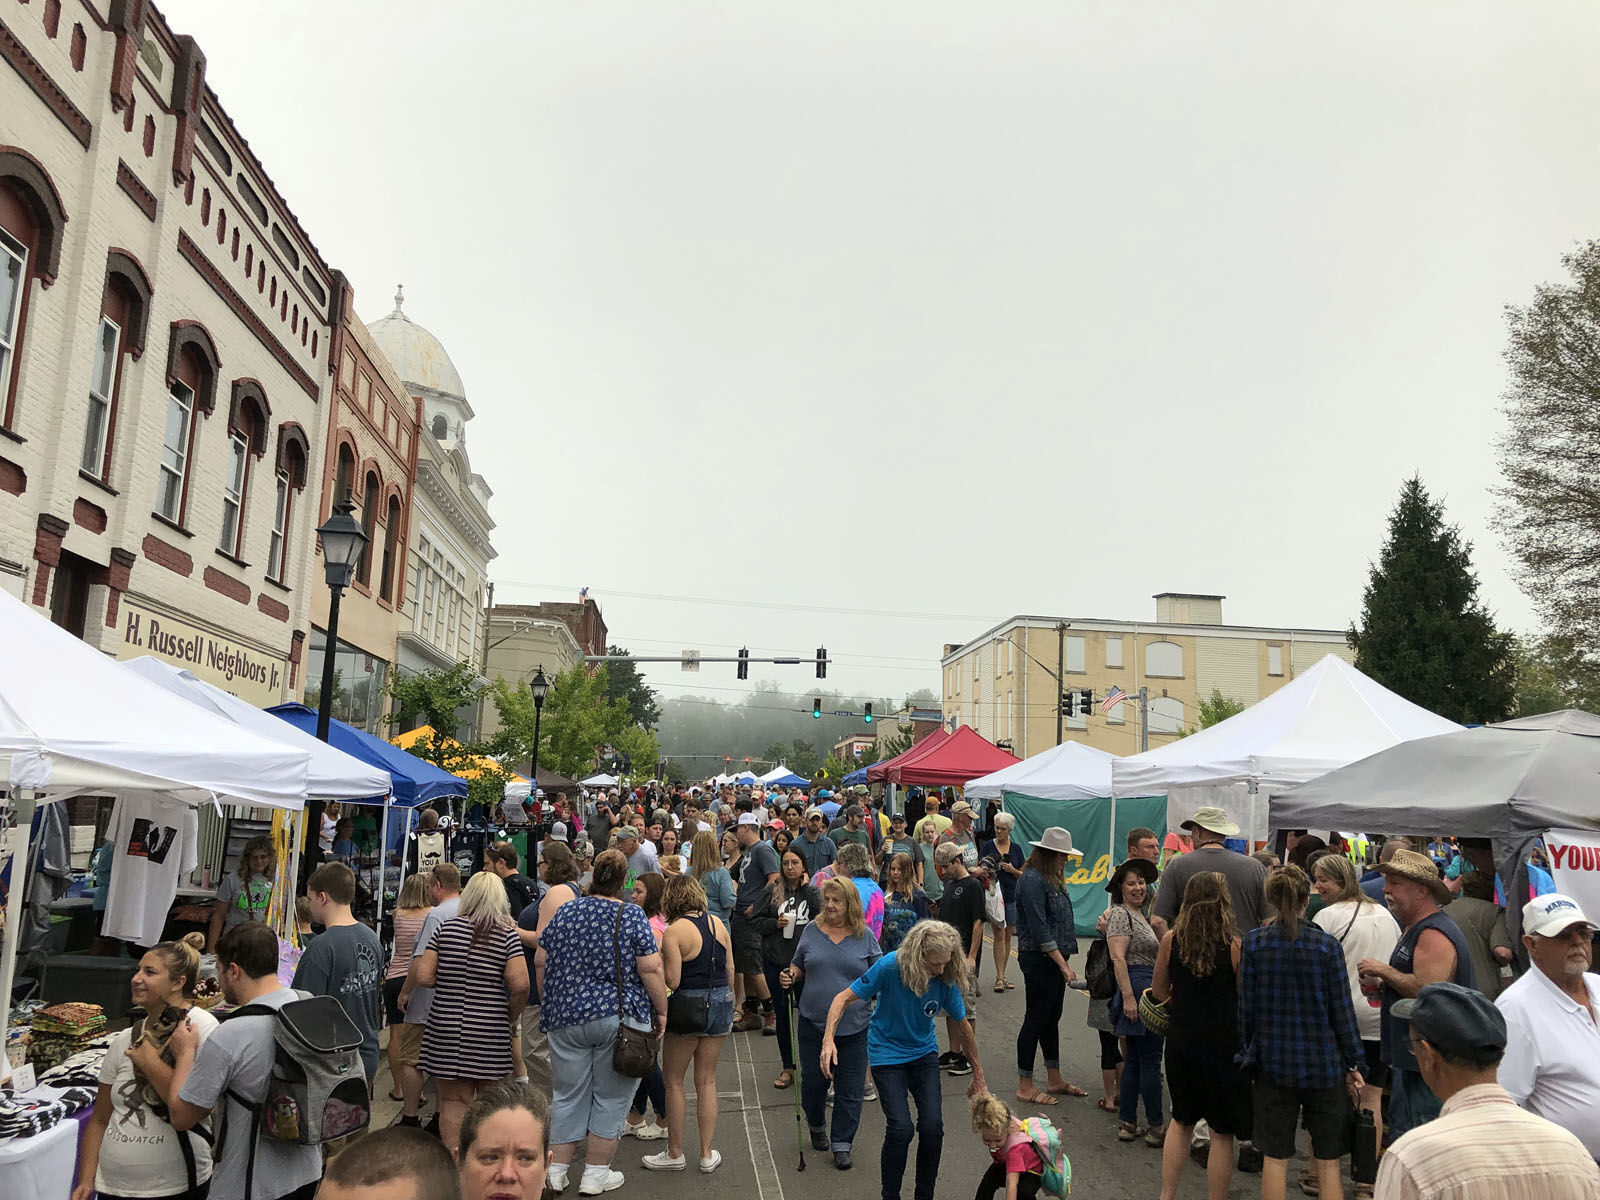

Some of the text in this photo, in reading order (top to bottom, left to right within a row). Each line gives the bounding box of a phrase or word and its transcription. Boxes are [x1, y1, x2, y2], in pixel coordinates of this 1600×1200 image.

[125, 611, 280, 693] H. Russell Neighbors Jr.
